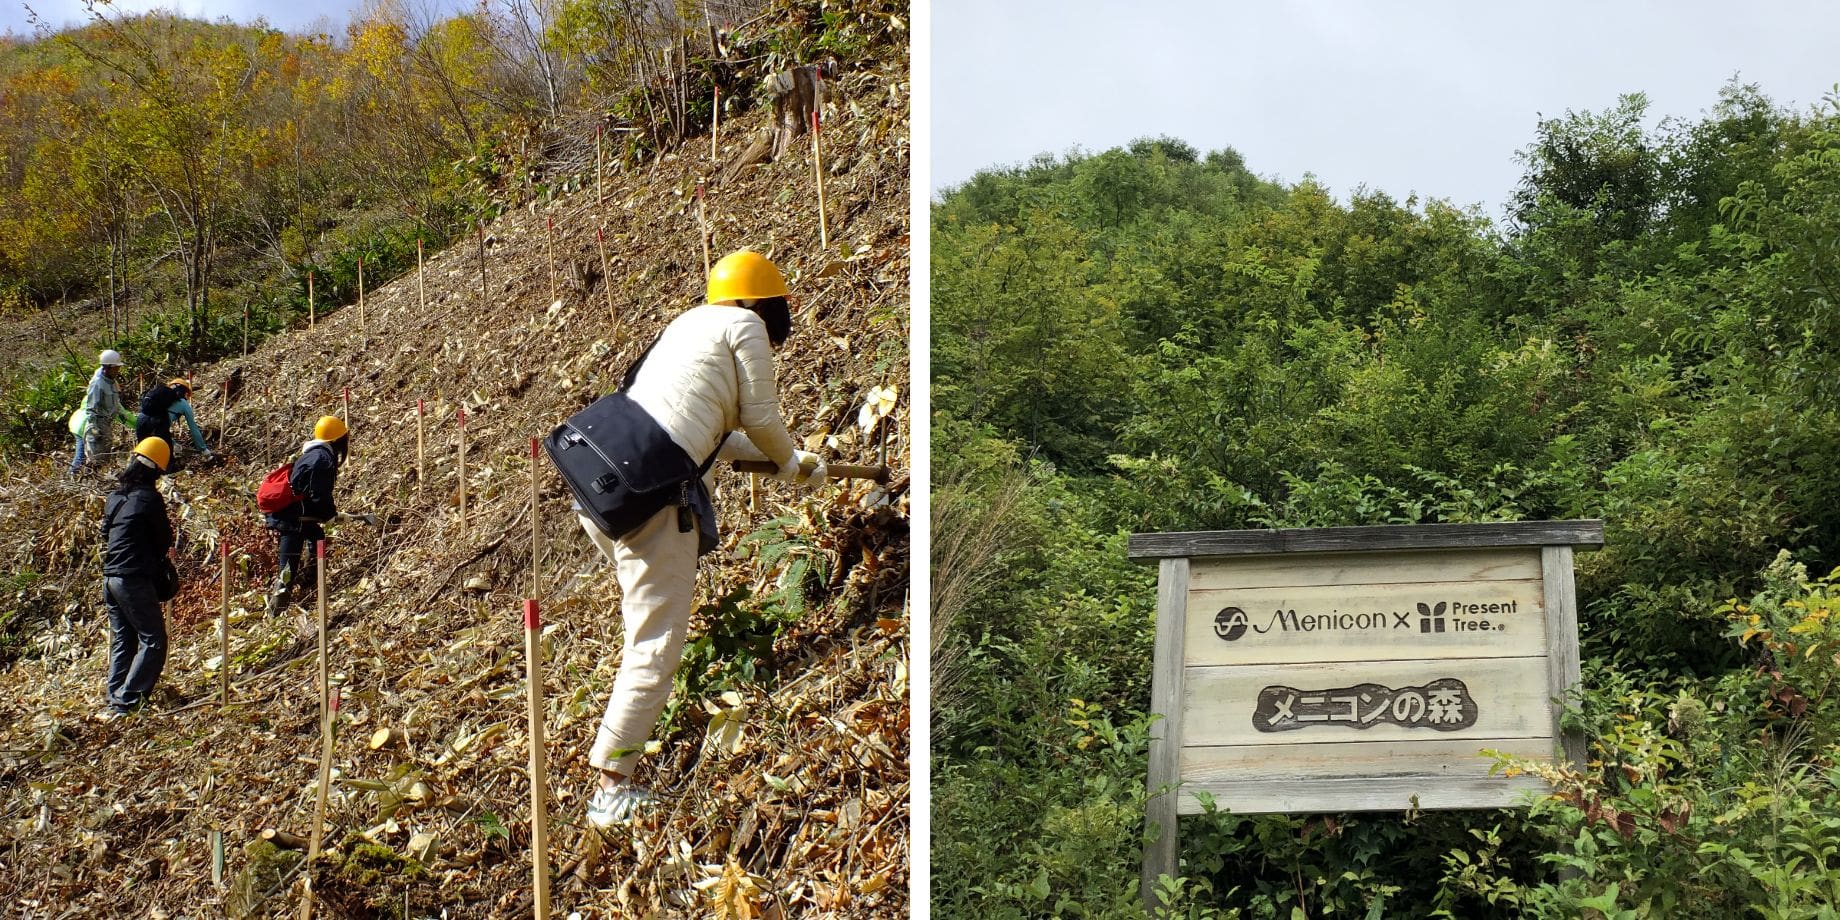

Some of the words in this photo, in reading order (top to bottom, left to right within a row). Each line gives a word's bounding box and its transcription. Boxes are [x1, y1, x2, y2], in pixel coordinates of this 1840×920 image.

[1452, 600, 1517, 615] Present
[1253, 609, 1386, 633] Menicon
[1267, 689, 1463, 726] メニコンの森
